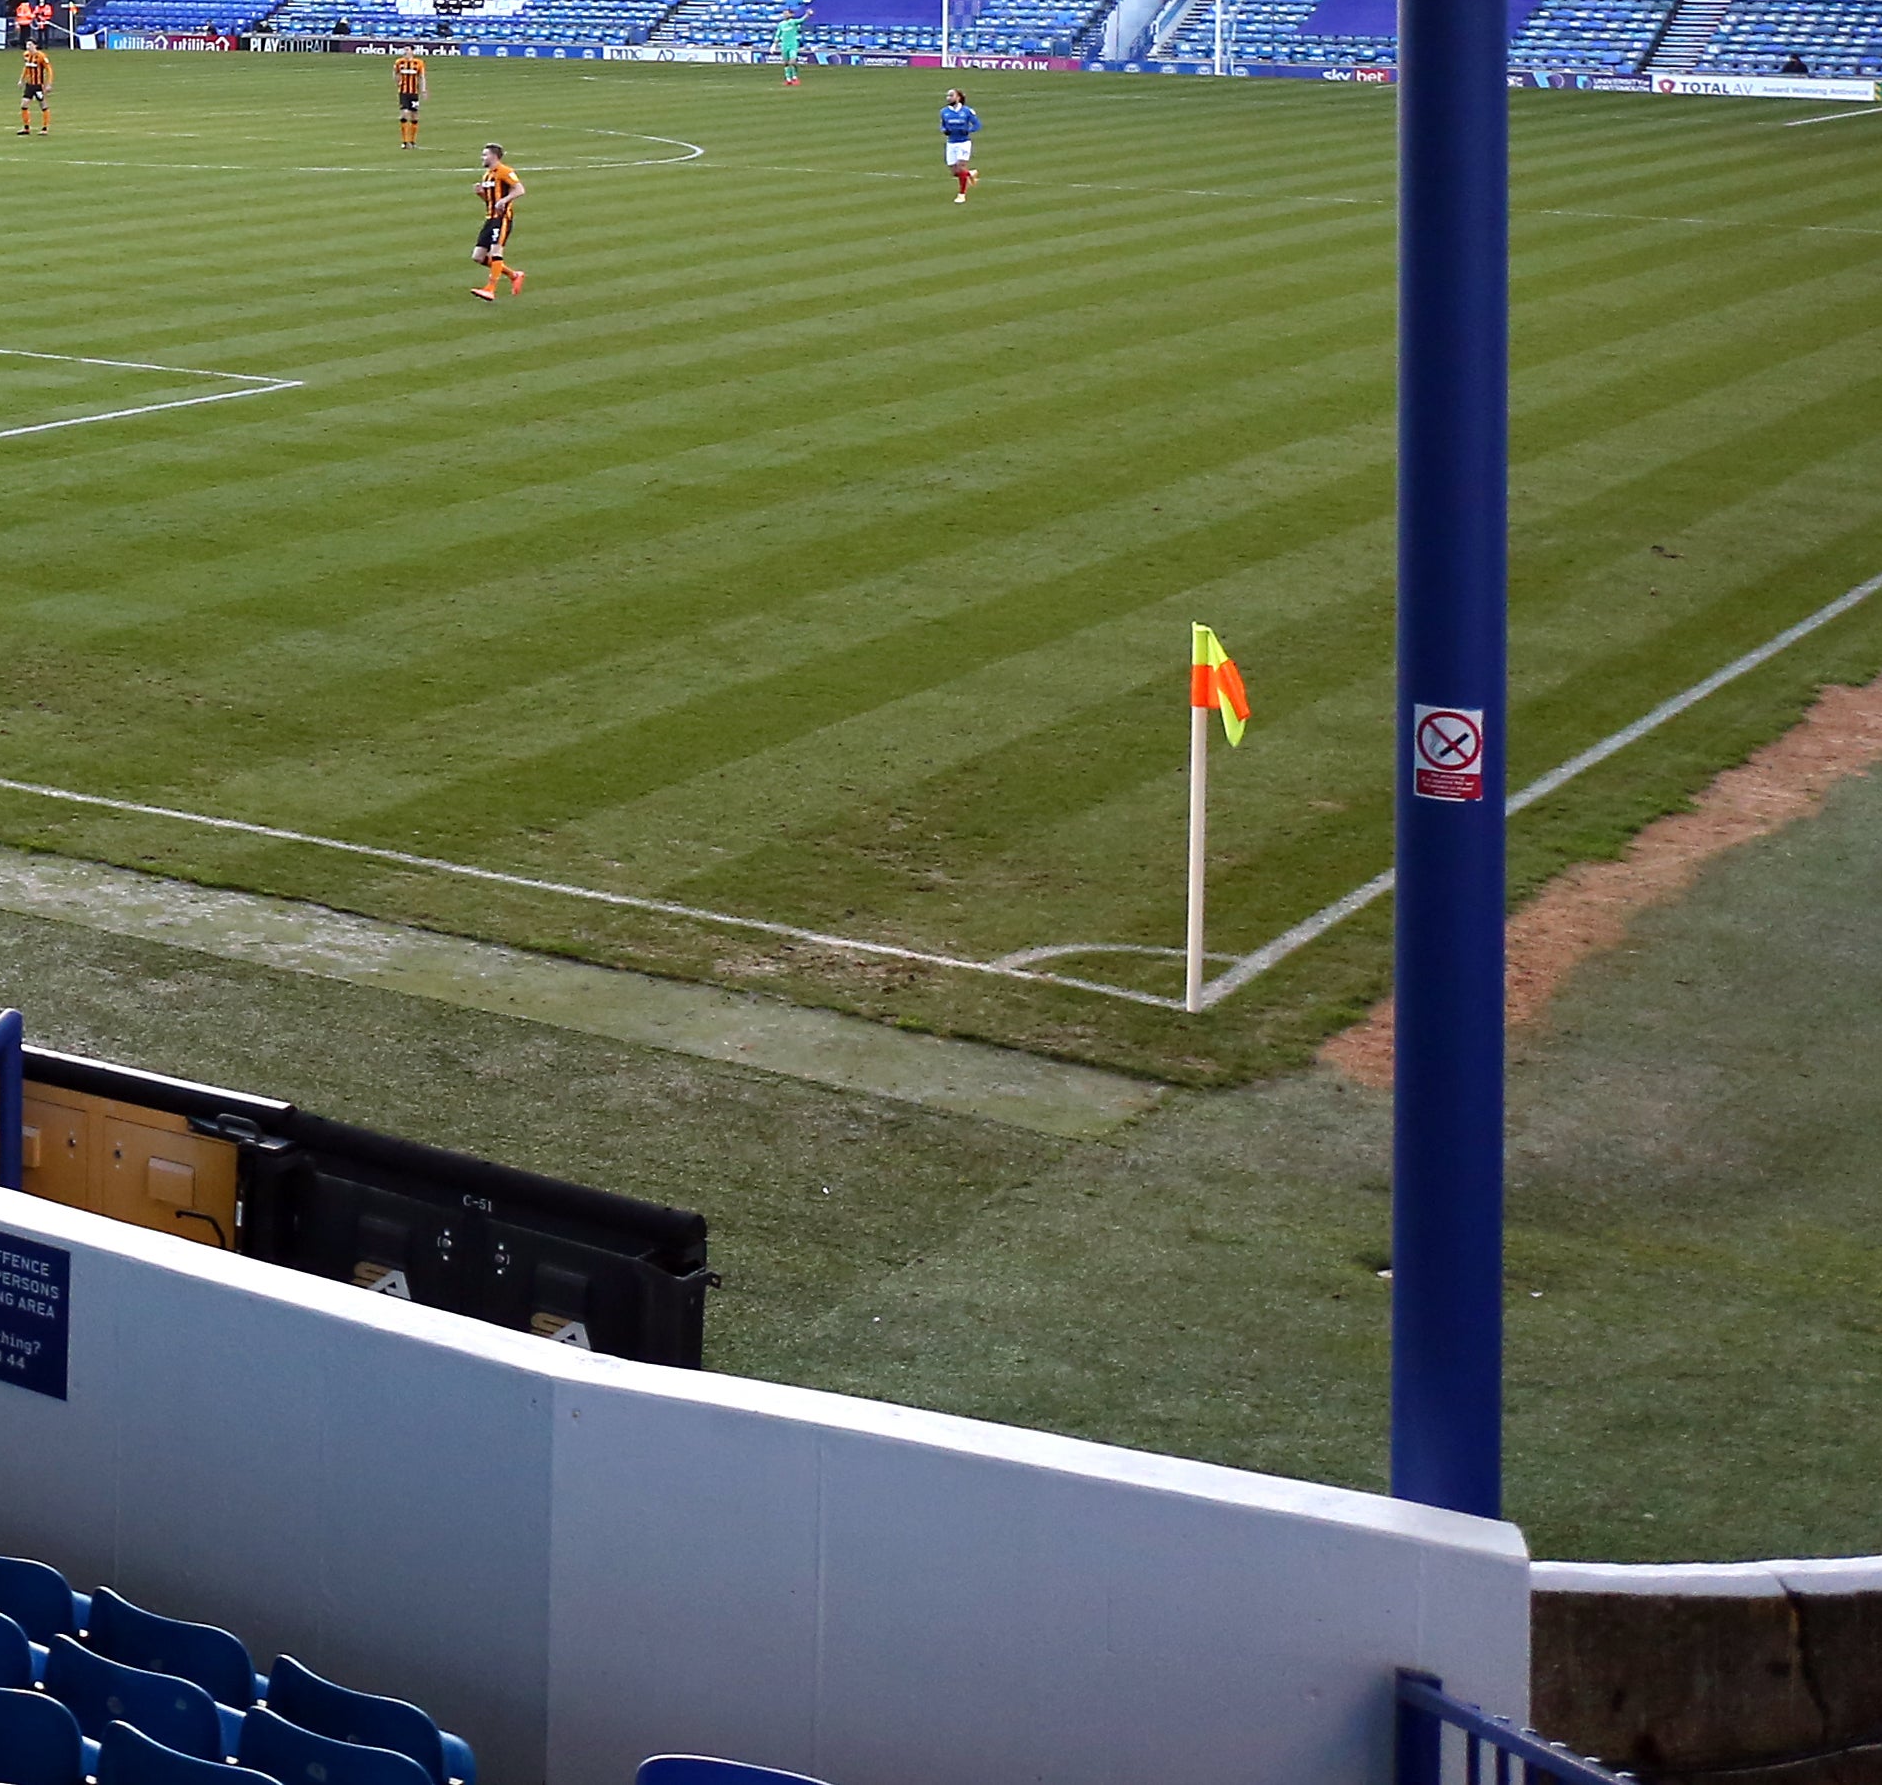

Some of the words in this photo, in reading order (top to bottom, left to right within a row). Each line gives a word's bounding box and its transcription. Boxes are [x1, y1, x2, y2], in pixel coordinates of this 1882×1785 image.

[114, 35, 154, 51] utilita
[173, 36, 215, 51] utilita
[433, 44, 461, 56] club
[1323, 69, 1351, 81] sky
[1356, 68, 1385, 82] bet
[1681, 82, 1730, 94] TOTAL
[463, 1194, 493, 1213] C-51
[18, 1296, 56, 1319] AREA
[6, 1354, 26, 1371] 44
